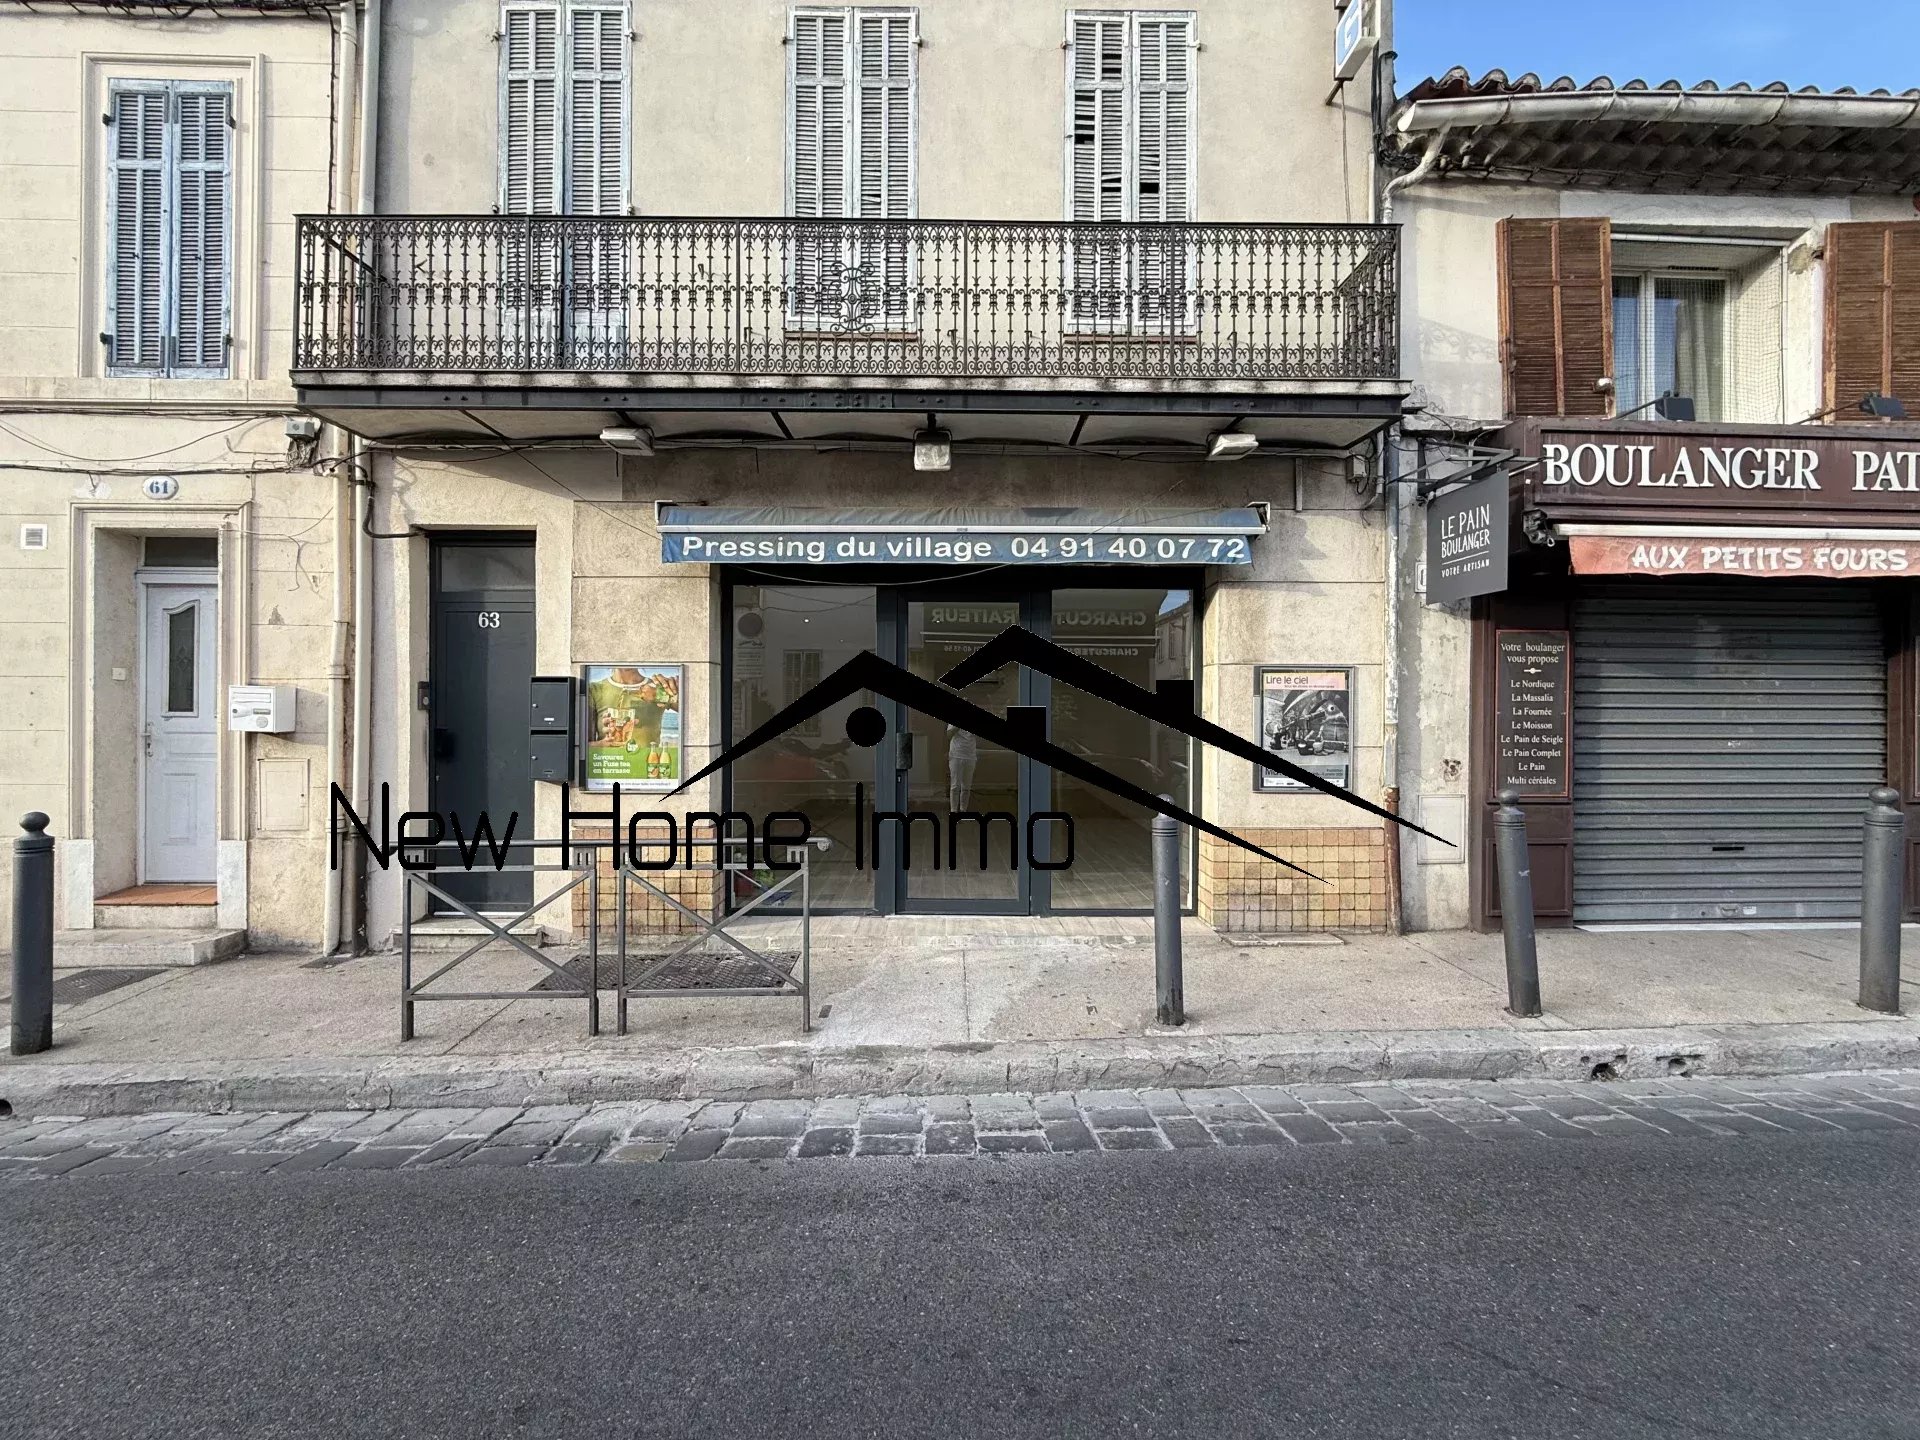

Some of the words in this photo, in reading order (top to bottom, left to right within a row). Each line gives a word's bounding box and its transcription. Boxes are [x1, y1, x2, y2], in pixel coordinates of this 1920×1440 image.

[1542, 443, 1821, 490] BOULANGER
[1851, 450, 1920, 491] PAT
[149, 479, 168, 494] 61
[1441, 515, 1456, 539] LE
[1459, 503, 1490, 534] PAIN
[1441, 528, 1491, 558] BOULANGER
[682, 536, 825, 562] Pressing
[829, 536, 875, 557] du
[886, 536, 992, 562] village
[1011, 537, 1050, 558] 04
[1059, 537, 1094, 558] 91
[1107, 537, 1147, 558] 40
[1157, 538, 1196, 559] 07
[1207, 538, 1245, 558] 72
[1631, 545, 1686, 569] AUX
[1702, 547, 1803, 570] PETITS
[1813, 547, 1909, 571] FOURS
[1441, 565, 1460, 578] VOTRE
[1463, 558, 1490, 573] ARTISAN
[478, 611, 500, 628] 63
[1500, 643, 1522, 652] Votre
[1525, 642, 1565, 654] boulanger
[1506, 655, 1526, 663] vous
[1527, 655, 1559, 665] propose
[1265, 676, 1282, 685] Lire
[1283, 675, 1292, 685] le
[1293, 675, 1309, 685] ciel
[1511, 679, 1520, 687] Le
[1522, 679, 1555, 689] Nordique
[1511, 693, 1522, 701] La
[1523, 693, 1554, 702] Massalia
[1512, 707, 1523, 715] La
[1524, 706, 1552, 715] Fournée
[1511, 721, 1521, 729] Le
[1523, 720, 1553, 729] Moisson
[1500, 735, 1510, 743] Le
[1514, 734, 1530, 743] Pain
[1531, 734, 1540, 743] de
[1541, 734, 1563, 745] Seigle
[1513, 748, 1529, 757] Pain
[1531, 748, 1561, 758] Complet
[1518, 762, 1528, 770] Le
[1529, 762, 1545, 770] Pain
[1507, 776, 1527, 784] Multi
[1528, 775, 1556, 784] céréales
